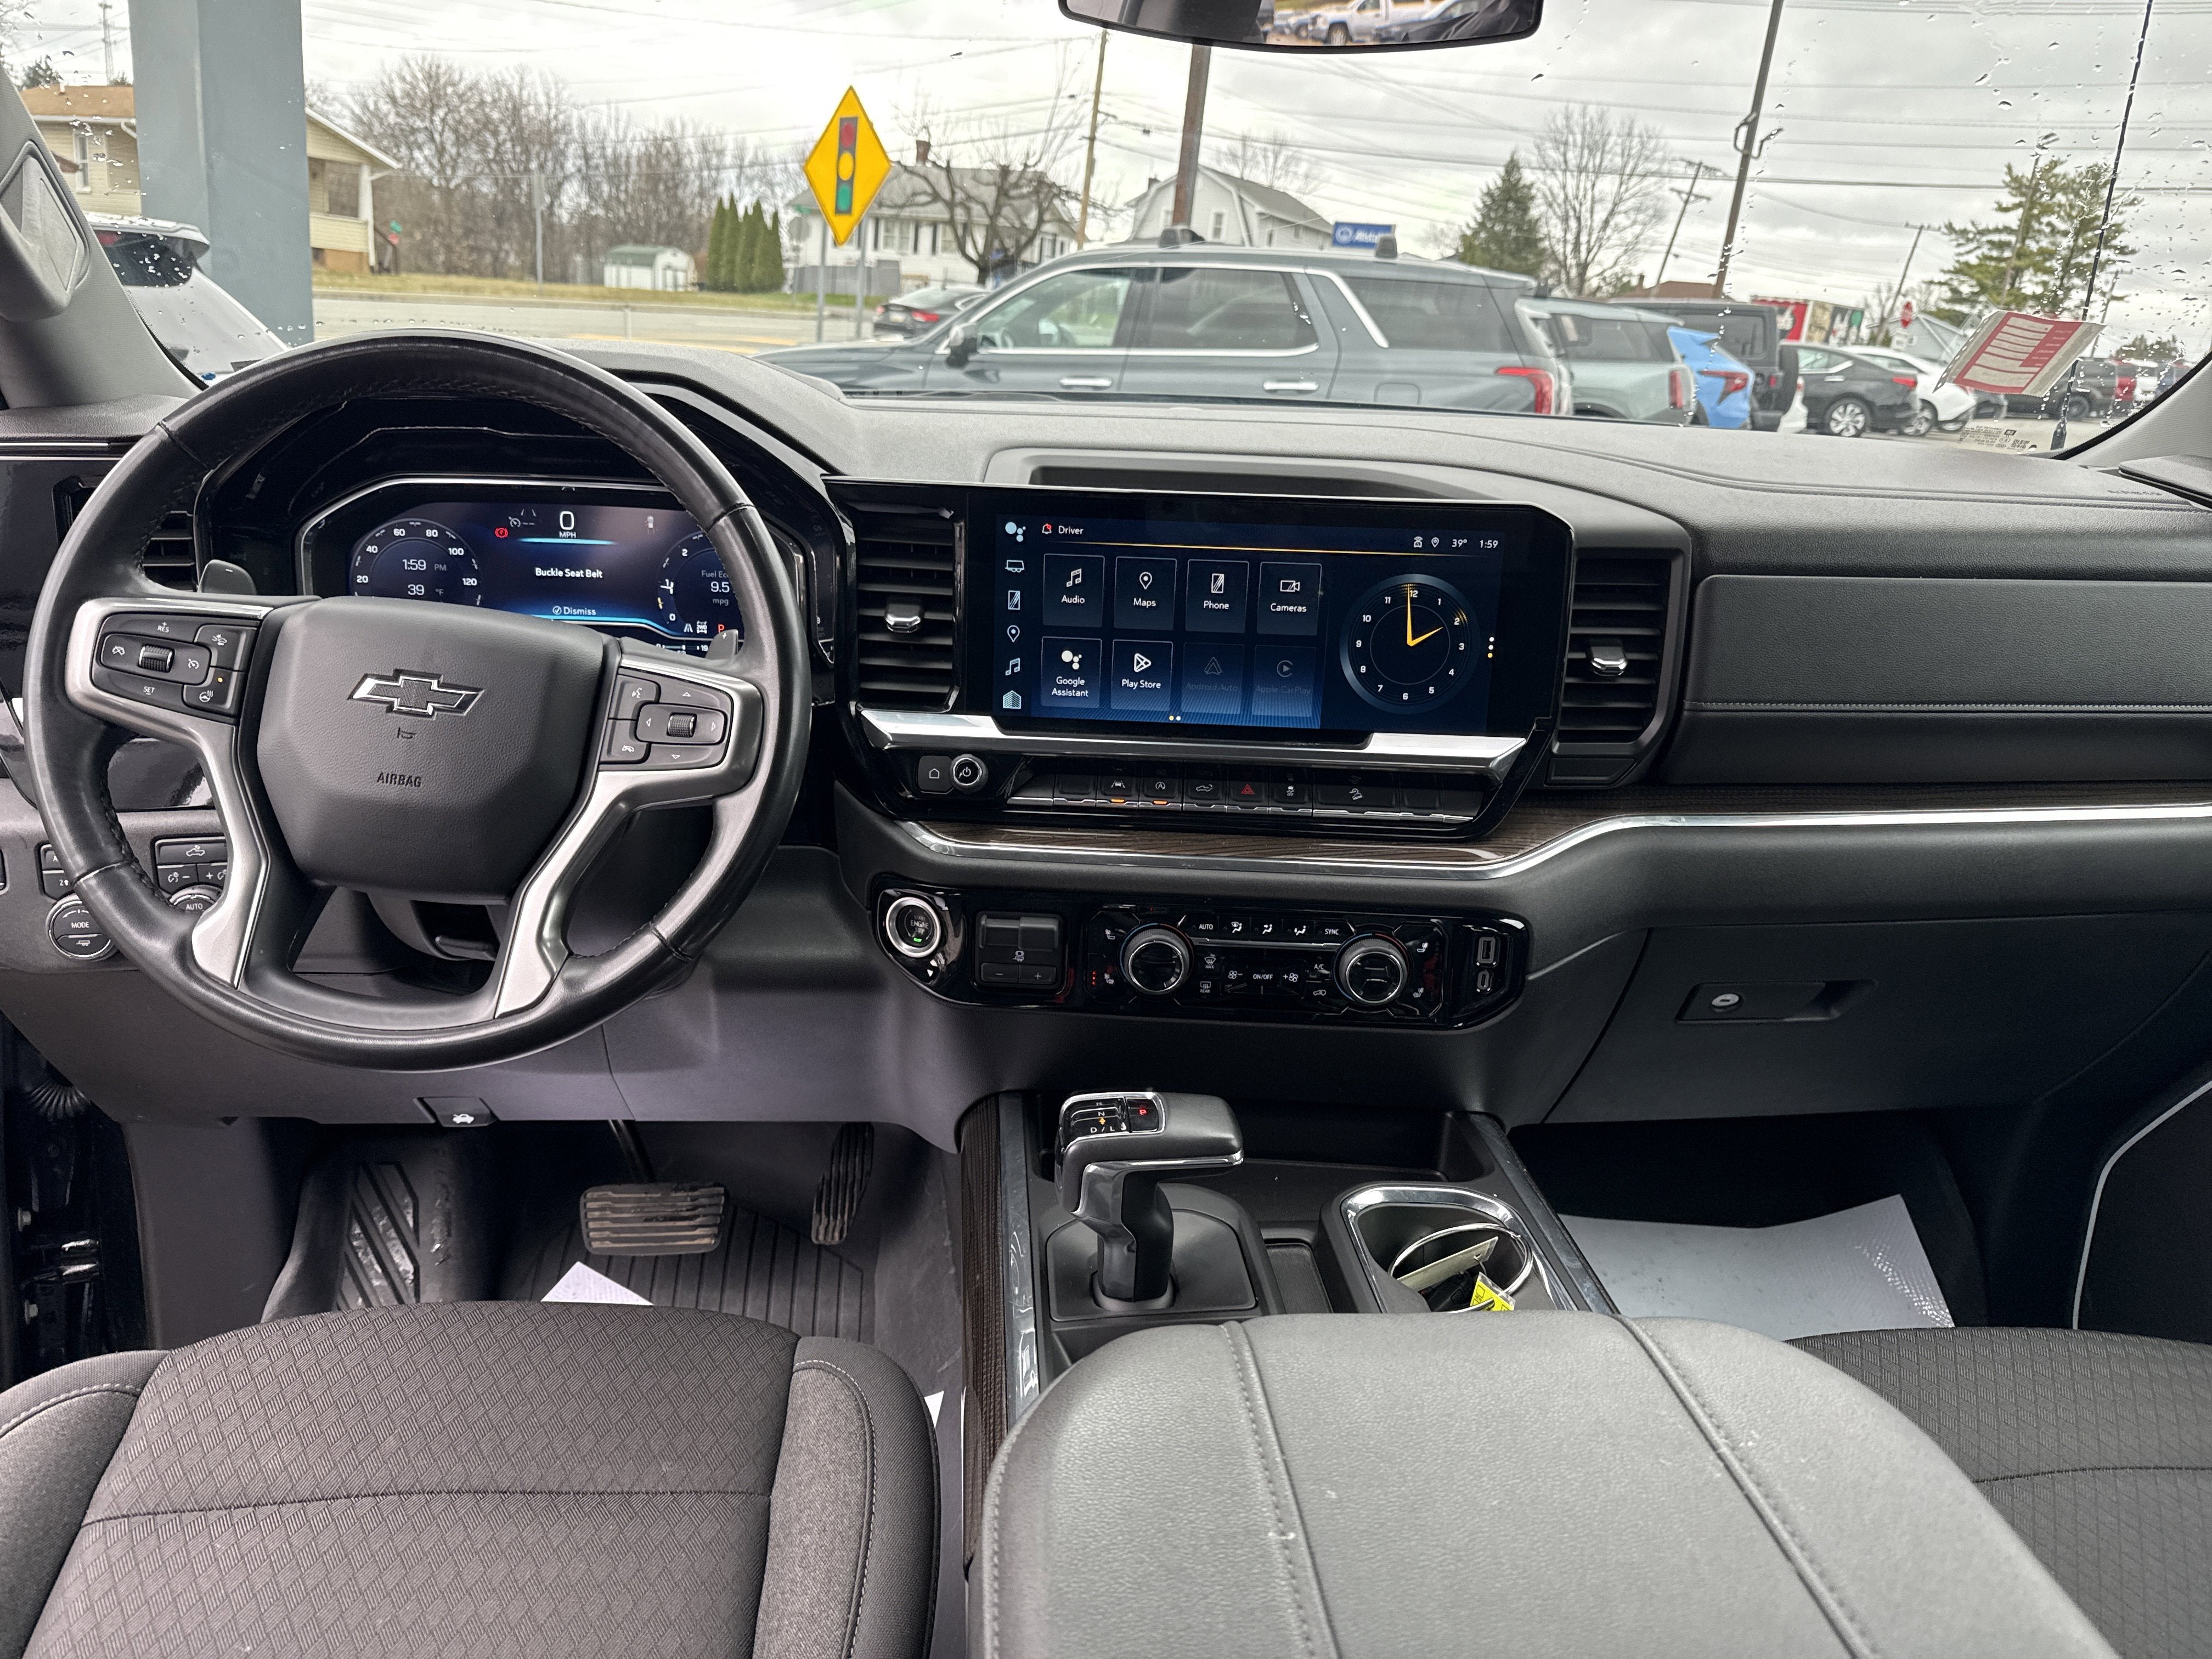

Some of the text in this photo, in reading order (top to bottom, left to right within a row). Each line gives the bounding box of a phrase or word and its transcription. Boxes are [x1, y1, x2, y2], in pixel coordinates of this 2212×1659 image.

[560, 511, 574, 531] 0
[393, 528, 405, 537] 60
[426, 529, 438, 538] 80
[1058, 526, 1084, 535] Driver
[1480, 540, 1498, 548] 1:59
[366, 545, 378, 554] 40
[448, 548, 464, 556] 100
[402, 559, 447, 572] 1:59 PM
[535, 567, 603, 578] Buckle Seat Belt
[357, 575, 368, 583] 20
[462, 578, 477, 586] 120
[408, 584, 425, 596] 39
[710, 582, 730, 593] 9.5
[712, 598, 729, 606] mpg
[1061, 595, 1085, 604] Audio
[1133, 597, 1156, 608] Maps
[1203, 600, 1229, 610] Phone
[1270, 603, 1307, 612] Cameras
[563, 606, 596, 616] Dismiss
[1362, 614, 1372, 623] 10
[718, 624, 725, 634] P
[1356, 640, 1362, 648] 9
[1459, 642, 1465, 651] 3
[1448, 668, 1454, 676] 4
[1056, 676, 1085, 687] Google
[1121, 679, 1161, 690] Play Store
[1186, 682, 1217, 690] Android
[1051, 688, 1088, 697] Assistant
[1256, 684, 1312, 696] Apple CarPlay
[376, 772, 422, 787] AIRBAG
